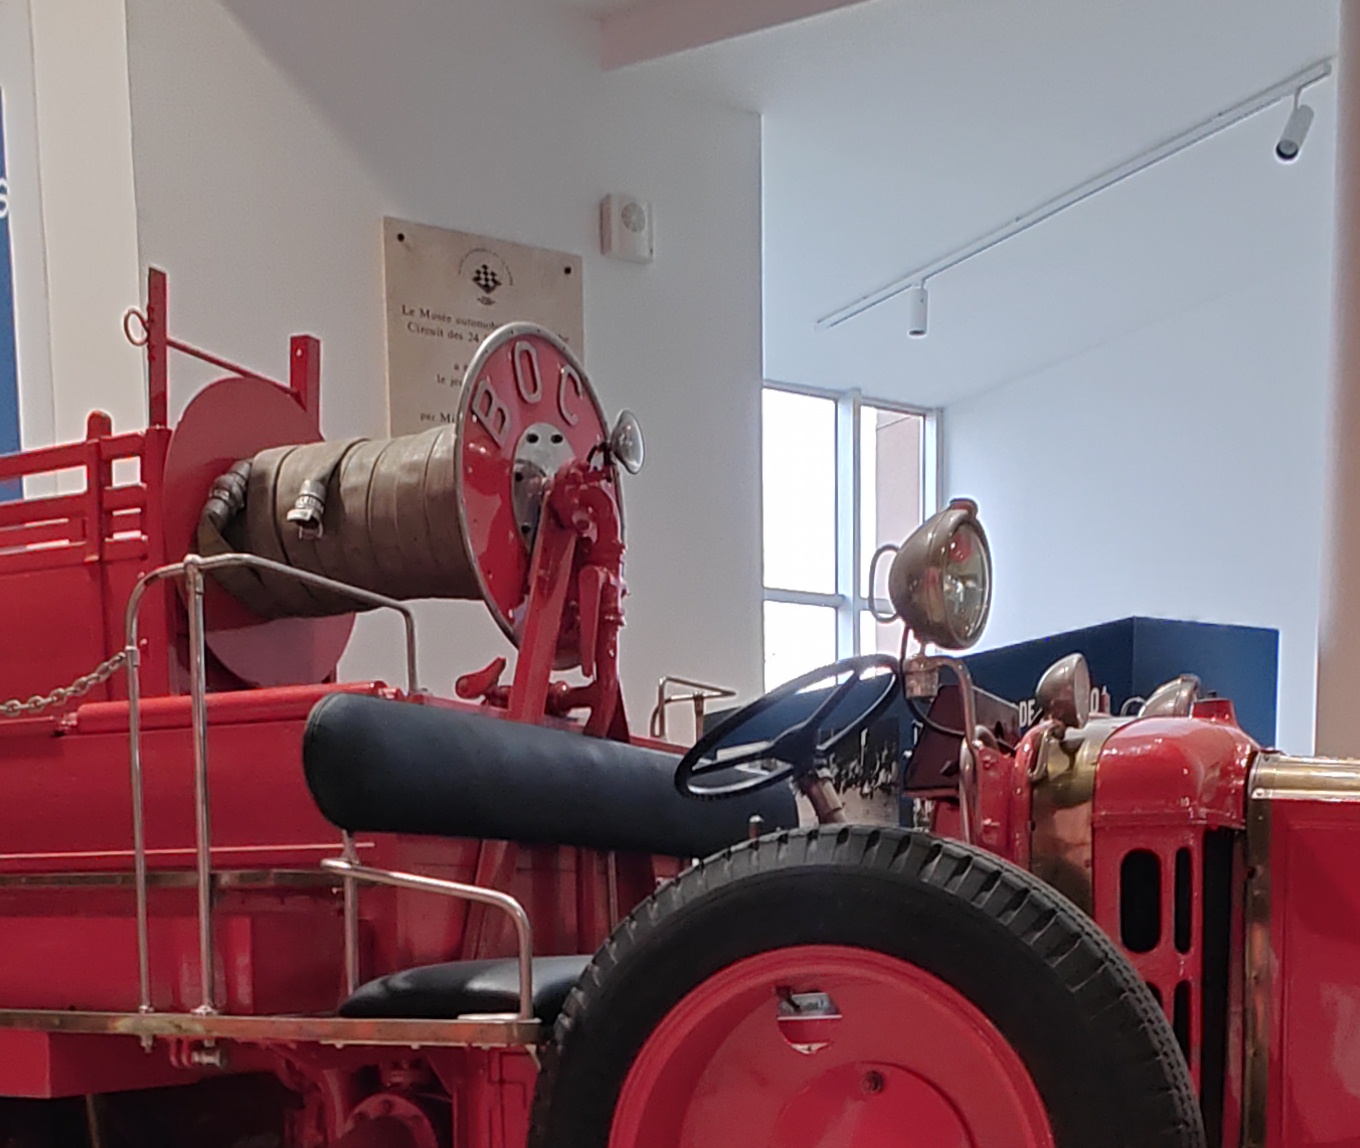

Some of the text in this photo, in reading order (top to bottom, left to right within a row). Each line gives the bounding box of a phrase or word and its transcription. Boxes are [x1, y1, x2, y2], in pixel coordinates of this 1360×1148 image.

[401, 303, 415, 316] Le
[419, 306, 452, 325] Musée
[407, 320, 444, 338] Circuit
[447, 329, 464, 341] des
[468, 331, 480, 343] 24
